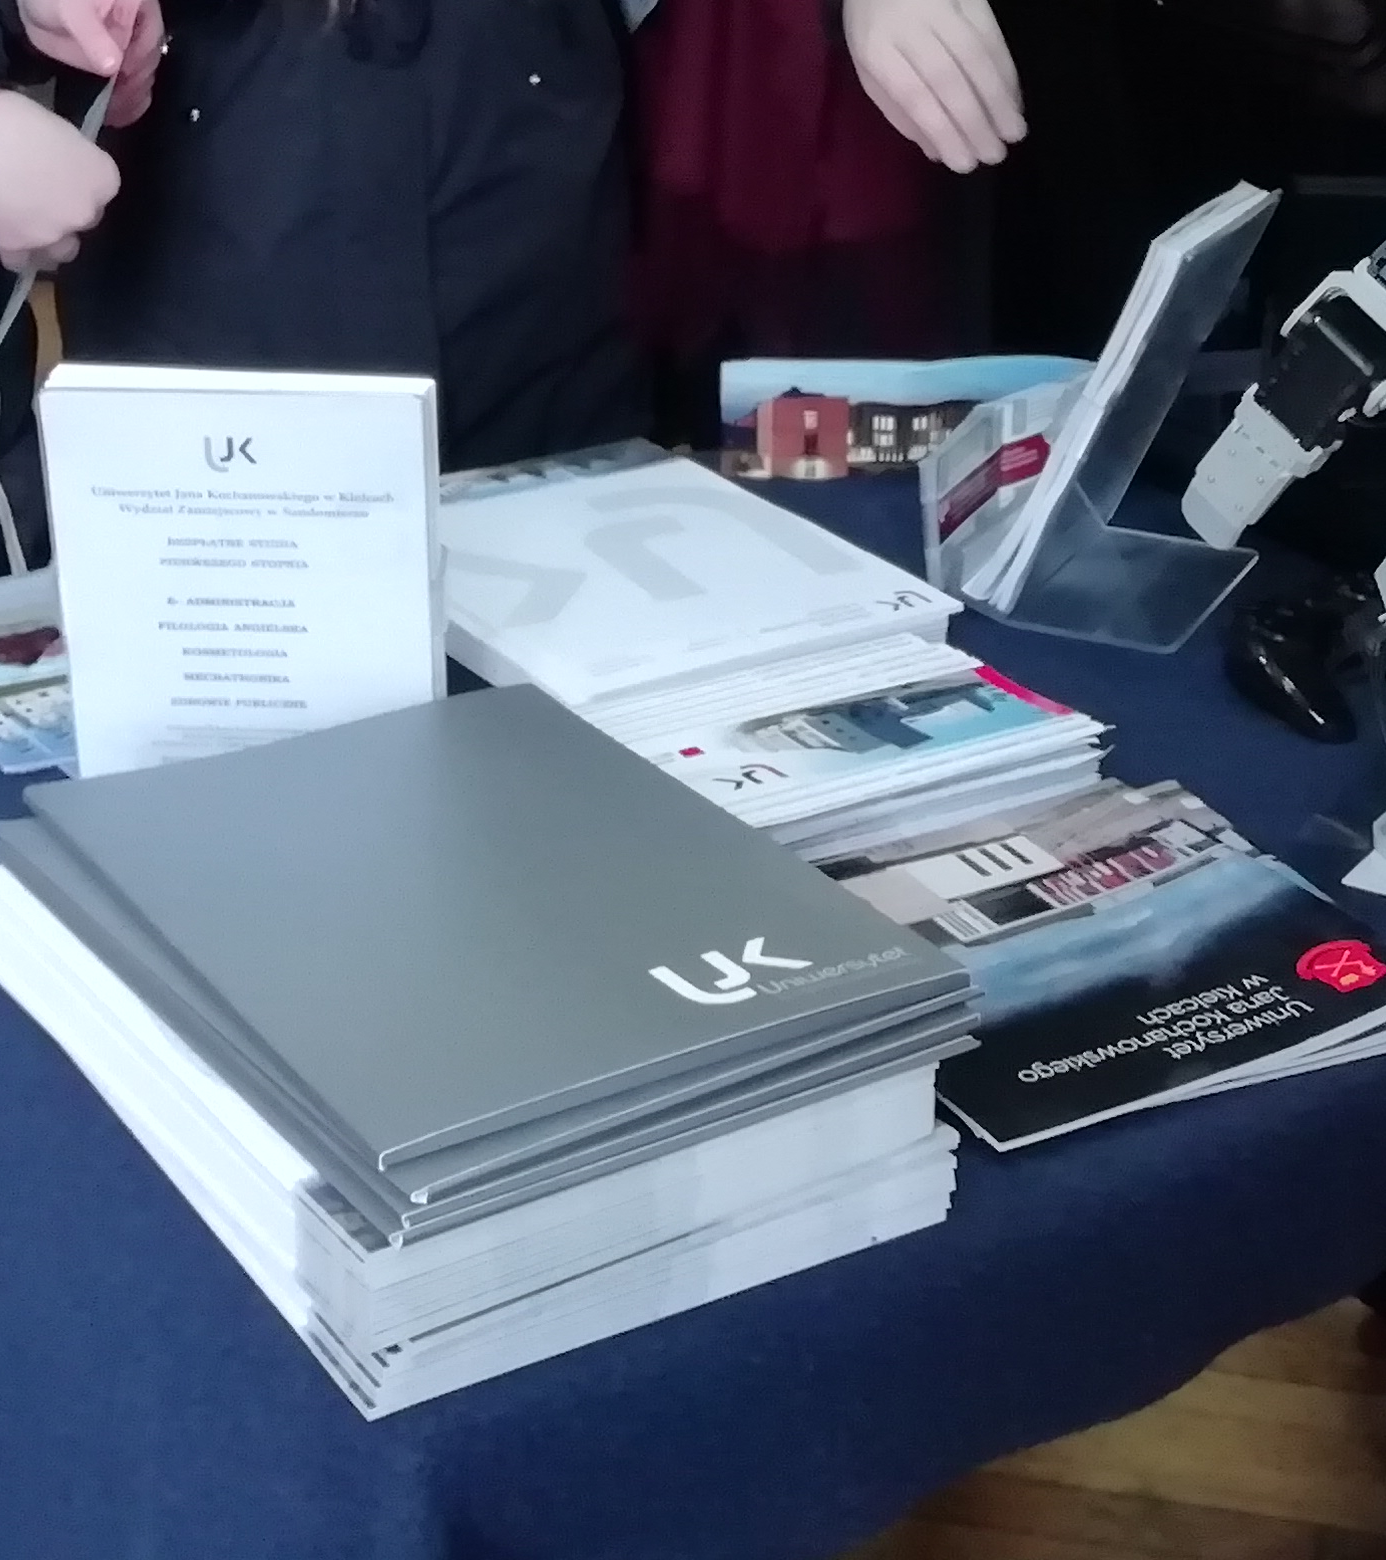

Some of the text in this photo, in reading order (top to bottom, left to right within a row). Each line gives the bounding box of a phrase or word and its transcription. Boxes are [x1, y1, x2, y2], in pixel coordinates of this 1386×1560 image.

[1018, 986, 1290, 1083] Jana Kochanowskiego
[1136, 983, 1243, 1026] Kielcach
[1162, 999, 1314, 1060] Uniwersytet
